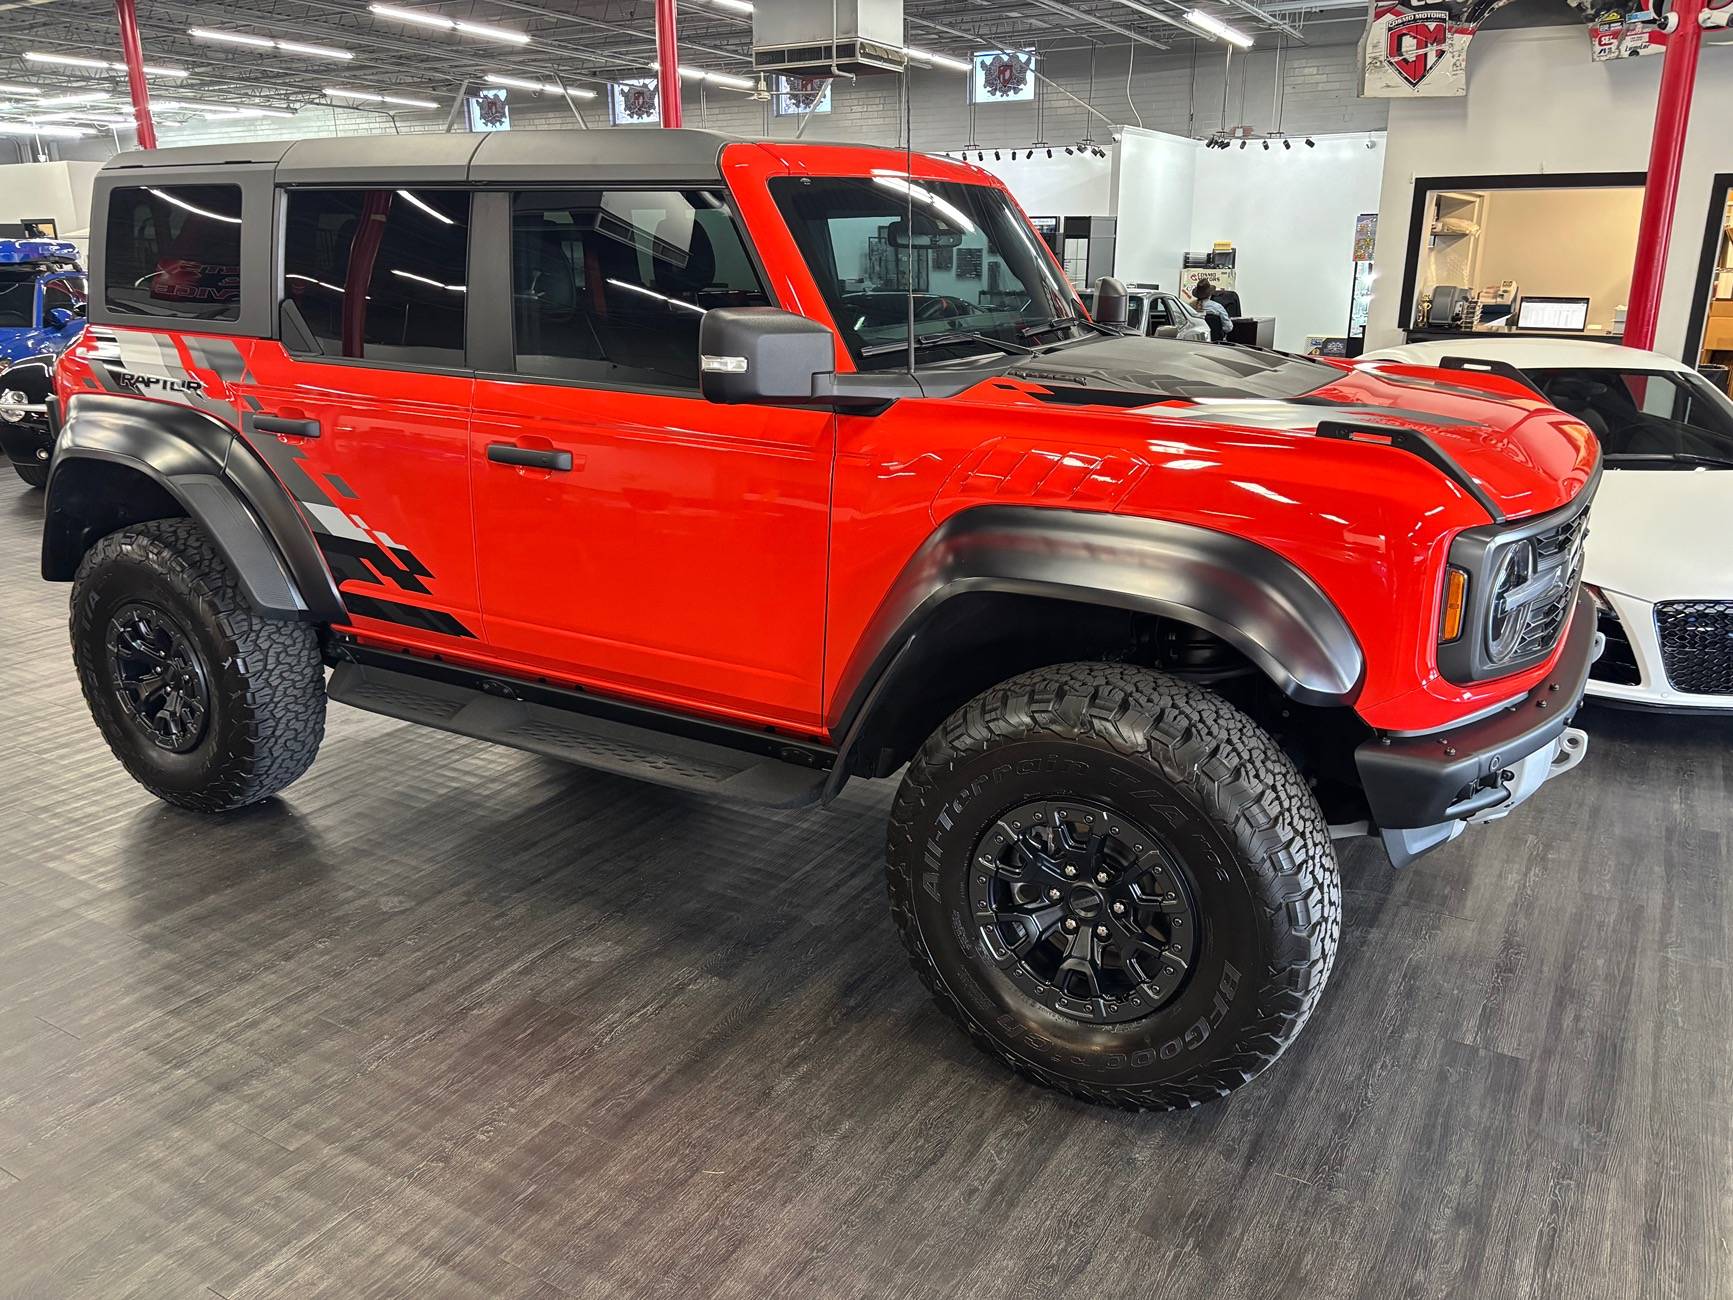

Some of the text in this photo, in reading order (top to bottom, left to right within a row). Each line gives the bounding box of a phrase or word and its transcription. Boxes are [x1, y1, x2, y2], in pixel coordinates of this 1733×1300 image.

[1388, 11, 1447, 27] COSMO MOTORS
[120, 373, 206, 402] RAPTOR
